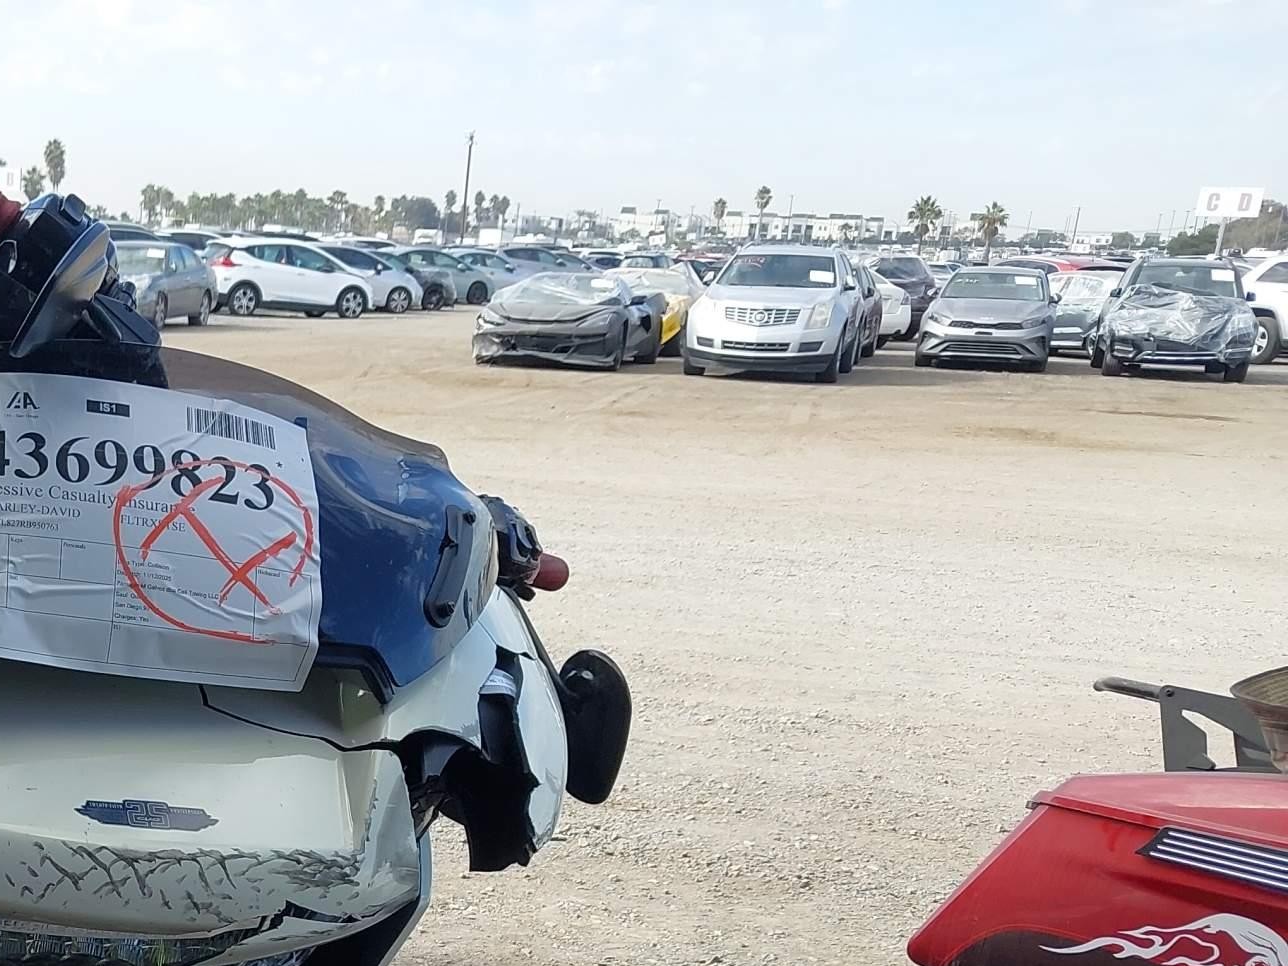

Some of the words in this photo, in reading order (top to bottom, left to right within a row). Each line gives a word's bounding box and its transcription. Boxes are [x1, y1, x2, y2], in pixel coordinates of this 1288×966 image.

[1206, 193, 1221, 211] C
[1238, 193, 1253, 211] D
[99, 402, 117, 413] IS1
[48, 485, 117, 509] Casualty
[124, 800, 171, 829] 25
